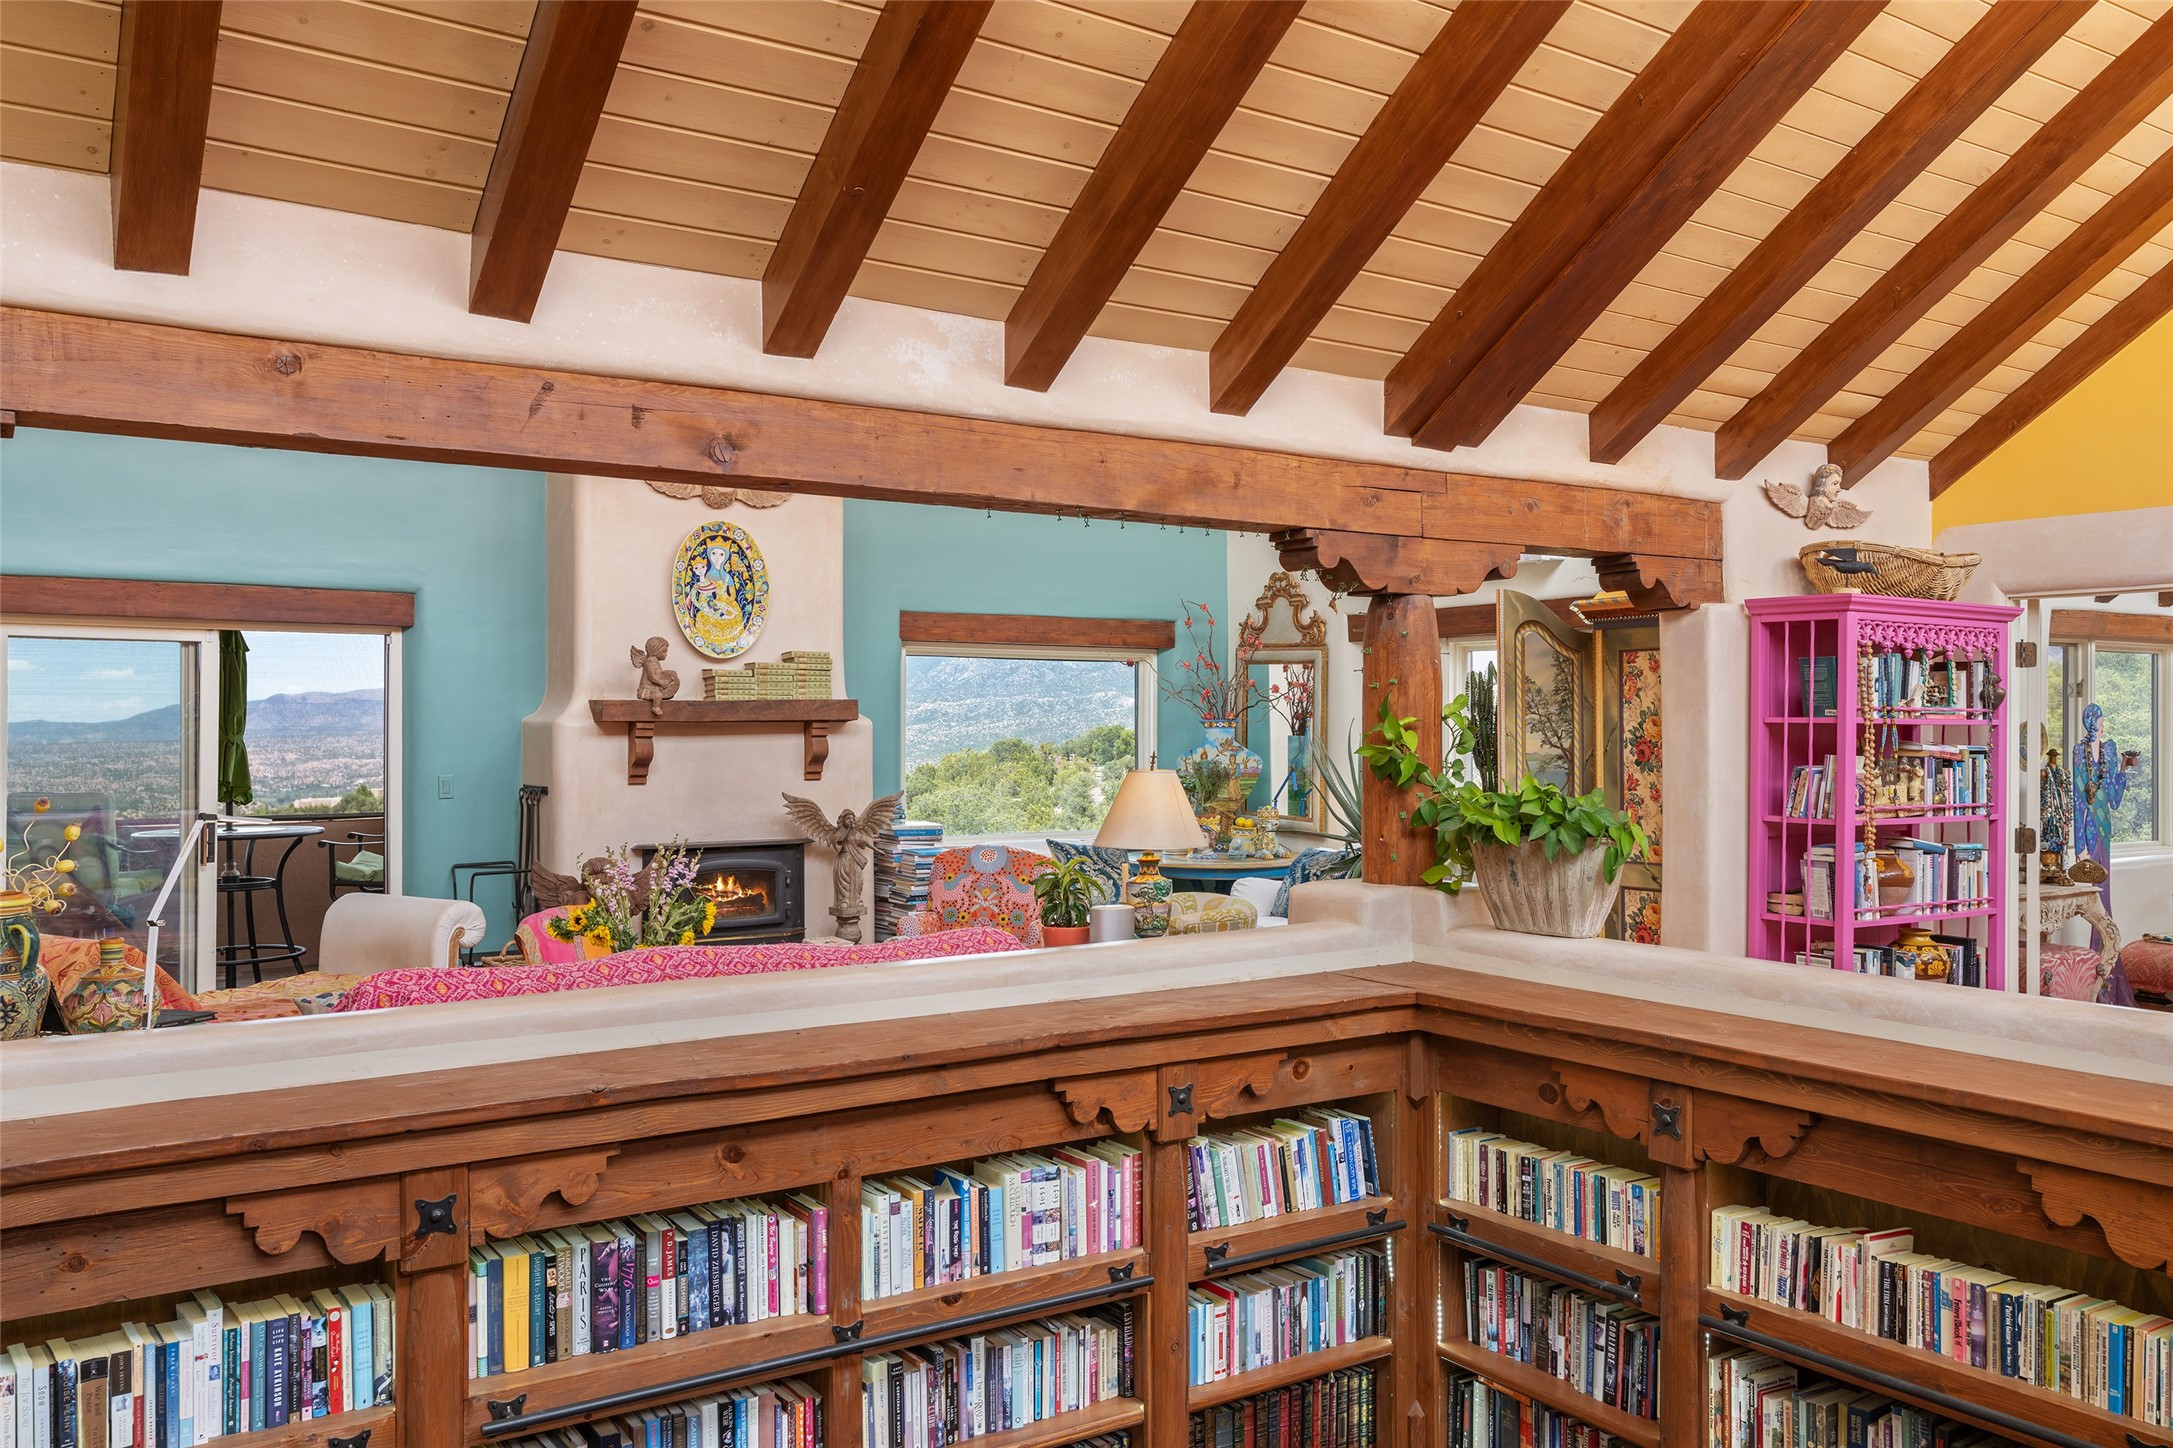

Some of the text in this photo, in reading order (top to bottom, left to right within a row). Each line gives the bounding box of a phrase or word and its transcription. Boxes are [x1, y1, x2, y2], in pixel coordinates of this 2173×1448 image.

[1611, 1190, 1620, 1211] ROOTS
[667, 1240, 674, 1249] D.
[768, 1238, 776, 1255] Buying
[1713, 1237, 1722, 1254] Garp
[1780, 1249, 1788, 1270] FOLLETT
[620, 1262, 635, 1290] 1776
[711, 1231, 720, 1313] DAVID ZEISBERGER
[1123, 1312, 1133, 1346] UNVEILED
[1953, 1298, 1963, 1339] Future Shock
[1607, 1320, 1616, 1365] COOLIDGE
[273, 1347, 282, 1407] KATE ATKINSON
[1756, 1375, 1796, 1390] European Society
[38, 1386, 48, 1406] Snow
